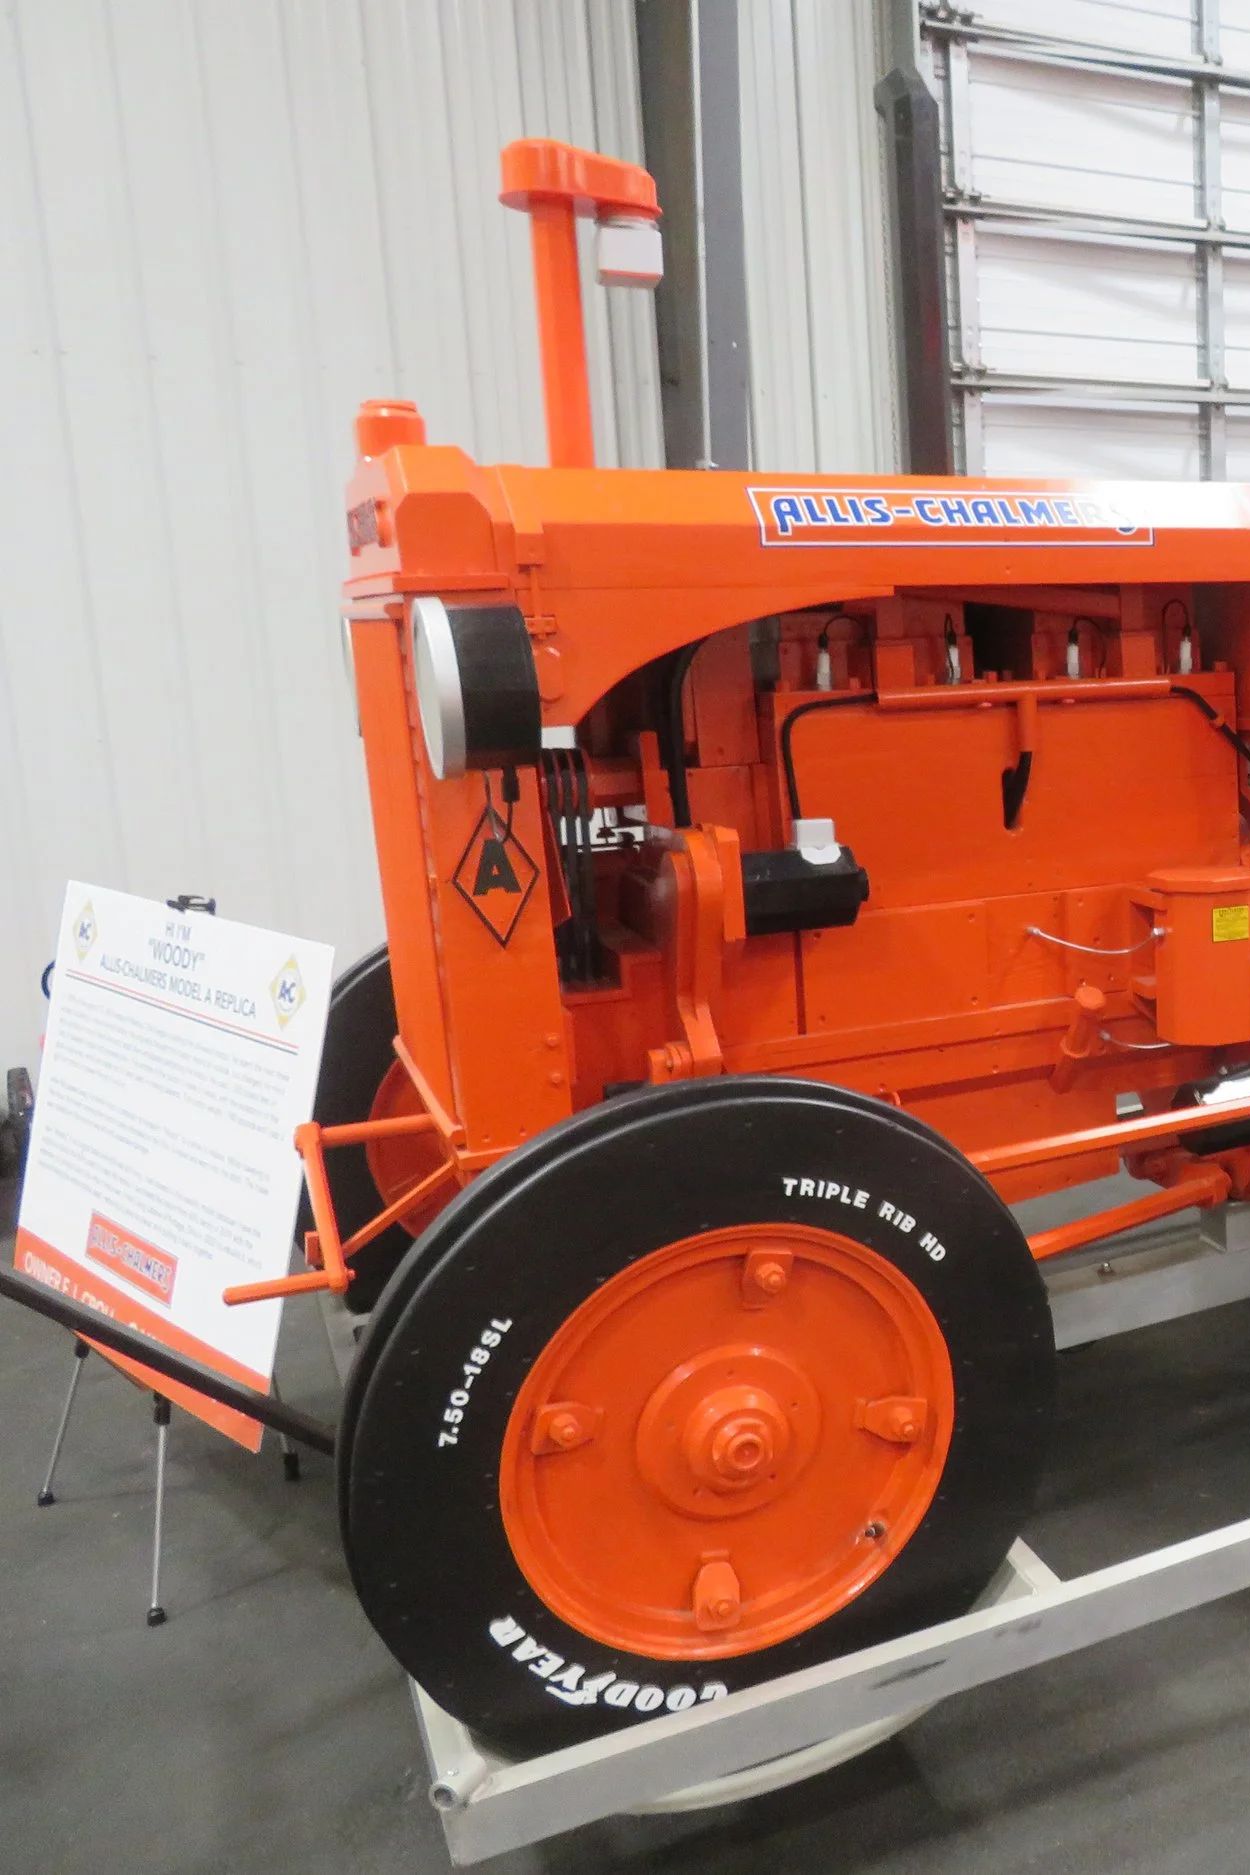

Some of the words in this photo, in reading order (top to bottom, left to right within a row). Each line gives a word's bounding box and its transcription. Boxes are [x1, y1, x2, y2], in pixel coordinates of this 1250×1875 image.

[473, 838, 522, 896] A
[100, 953, 168, 990] ALLIS-CHALMERS
[169, 974, 202, 1002] MODEL
[204, 987, 212, 1004] A
[214, 989, 257, 1018] REPLICA
[782, 1176, 871, 1209] TRIPLE
[877, 1200, 918, 1234] RIB
[919, 1231, 947, 1262] HD
[438, 1317, 513, 1448] 7.50-18SL
